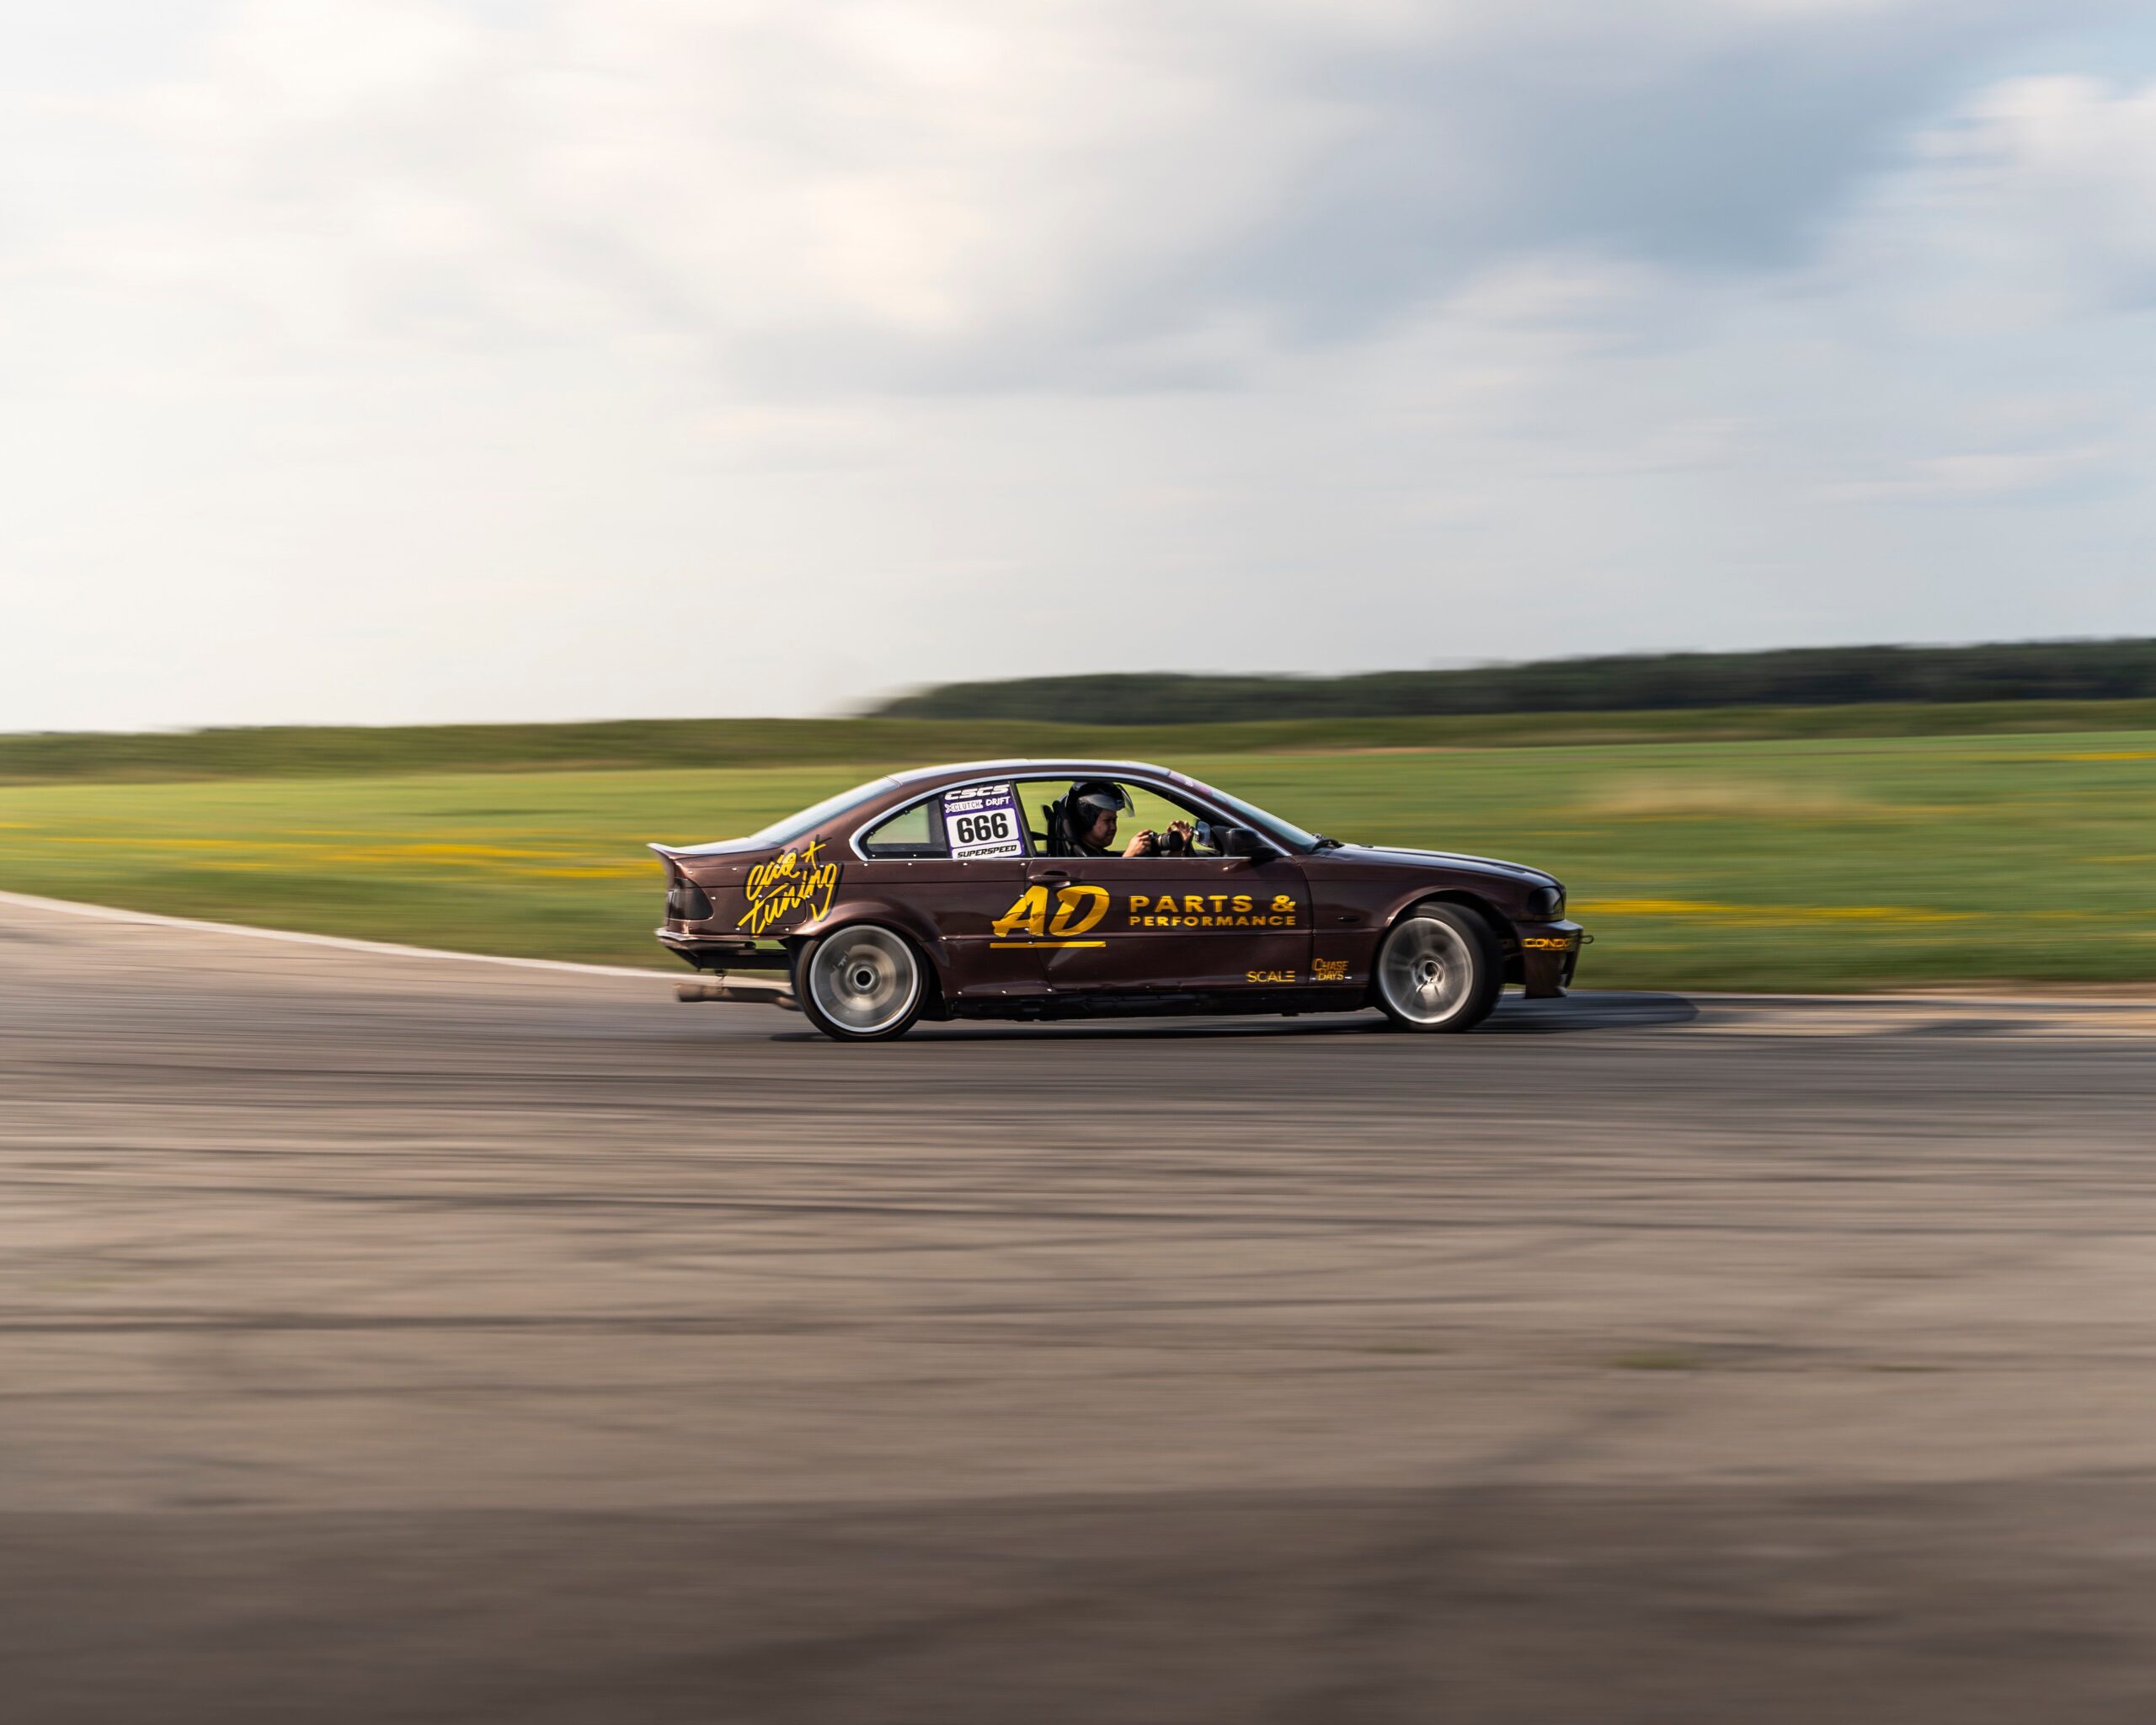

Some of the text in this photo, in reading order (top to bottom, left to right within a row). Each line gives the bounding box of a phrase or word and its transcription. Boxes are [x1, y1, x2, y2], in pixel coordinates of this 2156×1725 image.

[944, 784, 1010, 800] CSCS
[985, 796, 1011, 806] DRIFT
[957, 813, 1009, 843] 666
[957, 845, 1017, 857] SUPERSPEED
[1129, 895, 1296, 913] PARTS &
[991, 885, 1110, 937] AD
[1129, 916, 1296, 927] PERFORMANCE
[1312, 959, 1349, 971] CHASE
[1246, 970, 1295, 983] SCALE
[1317, 969, 1344, 981] BAYS
